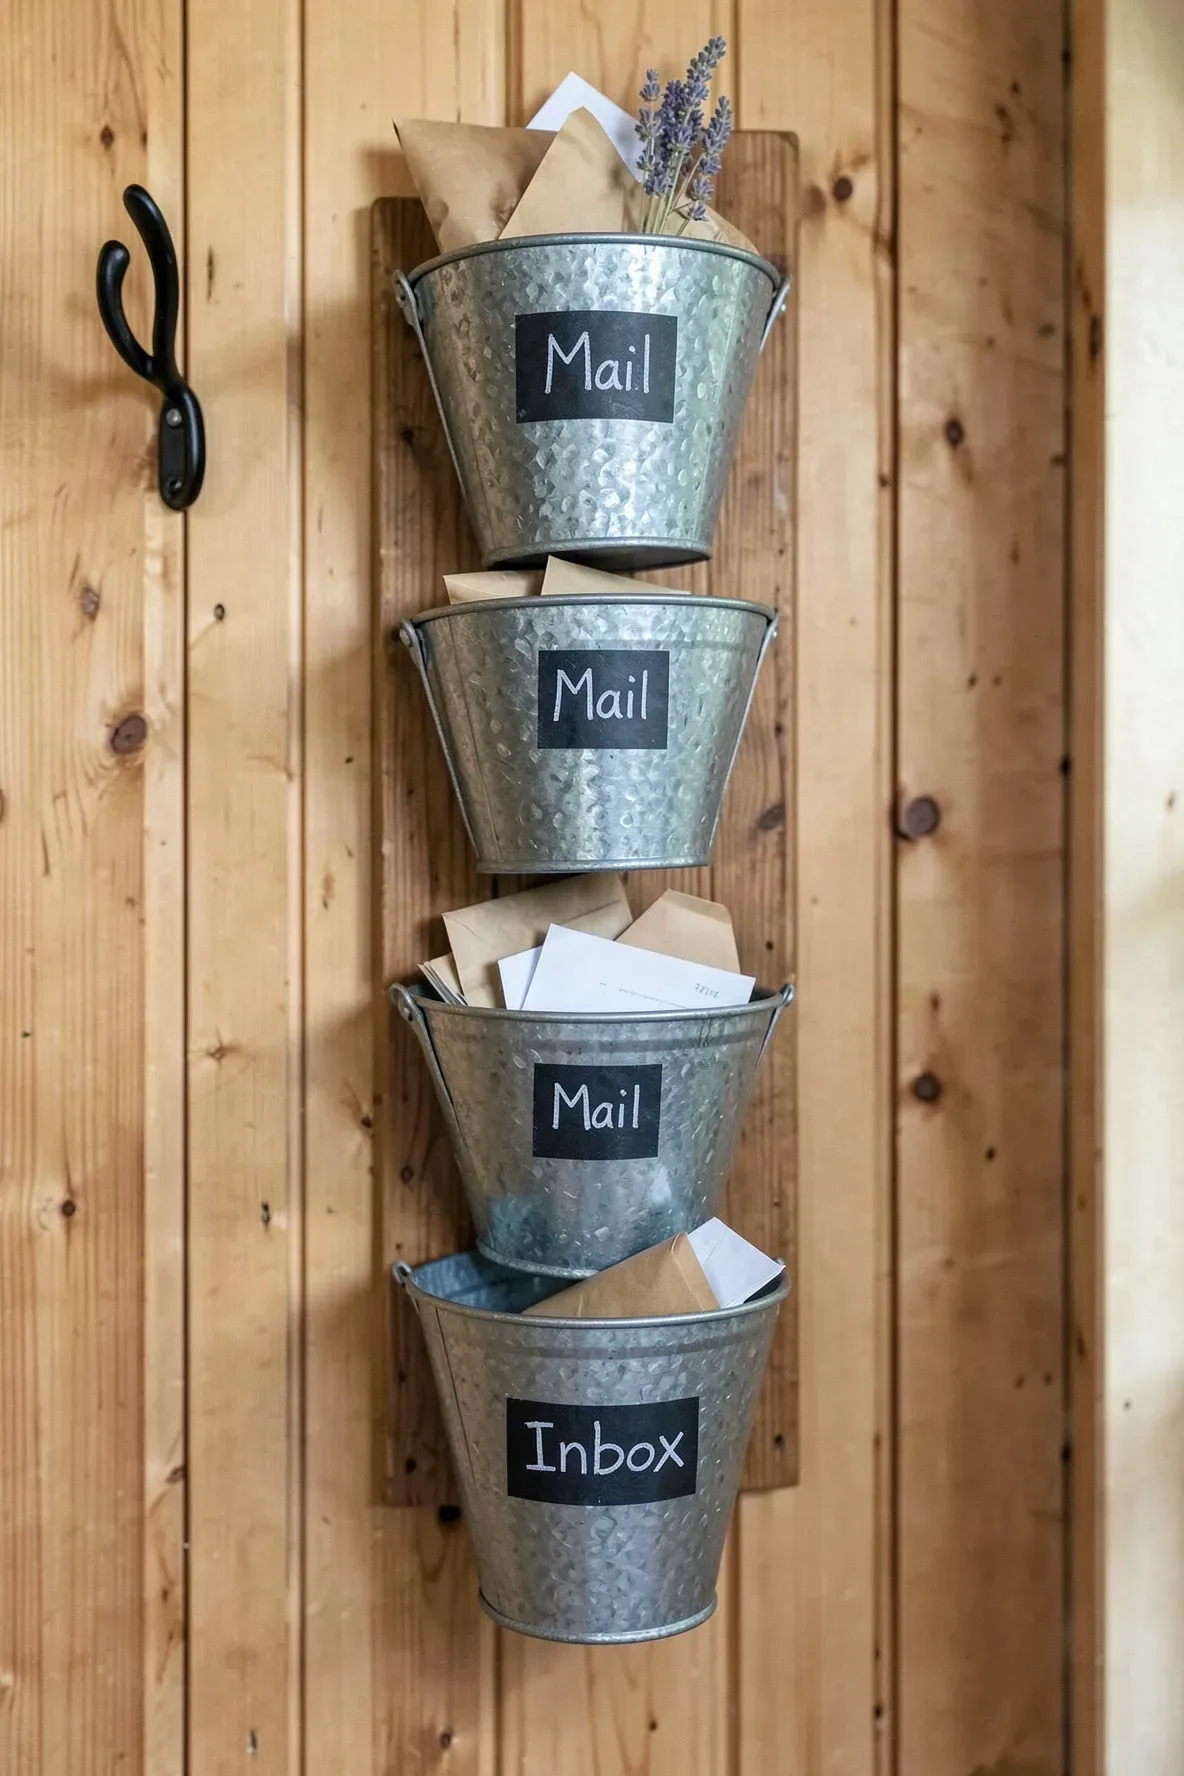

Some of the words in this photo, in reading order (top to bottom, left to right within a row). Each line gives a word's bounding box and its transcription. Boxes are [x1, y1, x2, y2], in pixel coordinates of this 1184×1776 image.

[544, 331, 650, 393] Mail
[553, 667, 648, 721] Mail
[551, 1082, 641, 1130] Mail
[524, 1420, 684, 1475] Inbox
